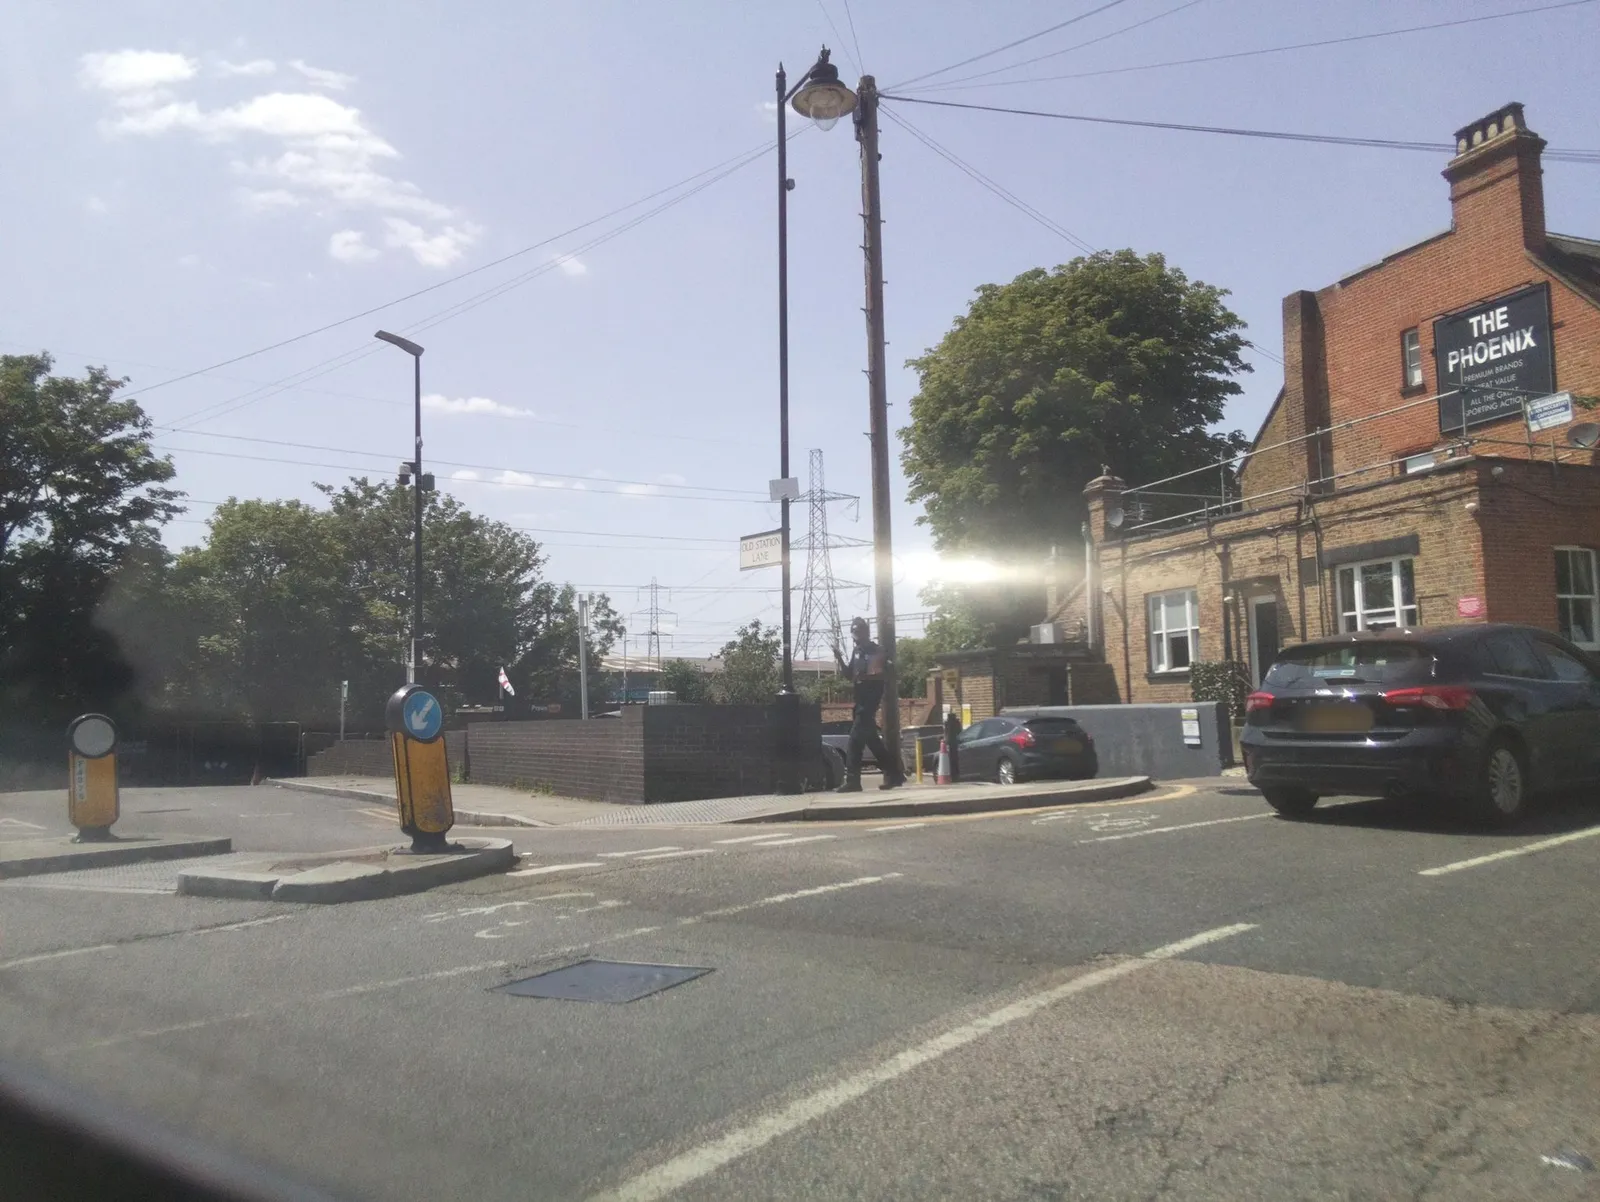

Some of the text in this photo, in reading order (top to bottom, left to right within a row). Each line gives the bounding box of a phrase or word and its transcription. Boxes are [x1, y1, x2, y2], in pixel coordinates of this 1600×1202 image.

[1468, 306, 1509, 338] THE
[1448, 325, 1537, 373] PHOENIX
[1464, 359, 1523, 382] PREMIUM BRANDS
[1496, 374, 1517, 386] VALUE
[1470, 396, 1483, 406] ALL
[1483, 391, 1496, 402] THE
[742, 536, 781, 552] OLD STATION
[752, 551, 769, 562] LANE
